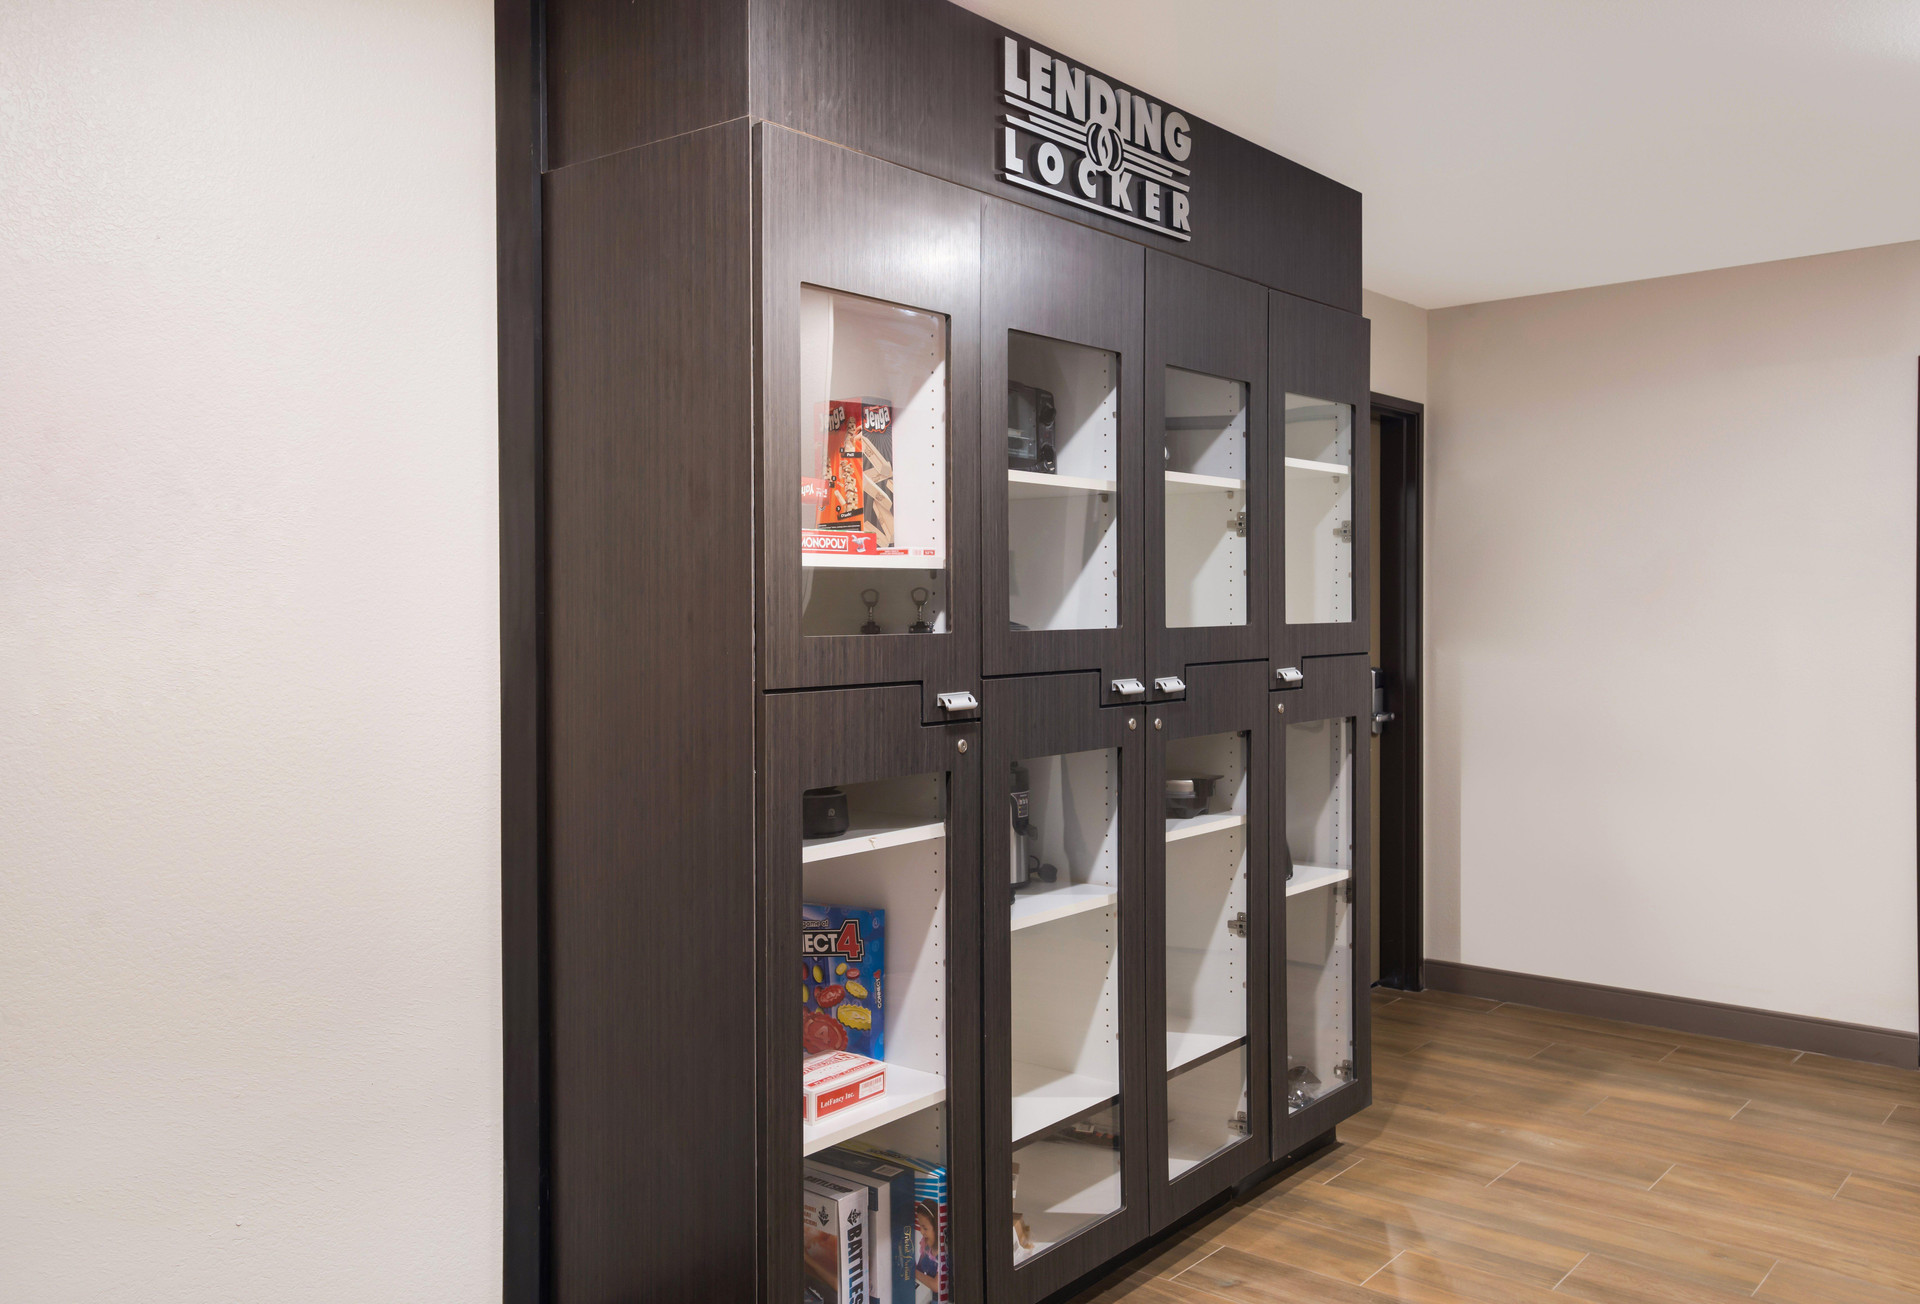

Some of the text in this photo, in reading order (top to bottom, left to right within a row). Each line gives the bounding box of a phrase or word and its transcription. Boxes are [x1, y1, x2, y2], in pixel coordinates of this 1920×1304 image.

[1005, 35, 1192, 162] LENDING
[1005, 126, 1192, 232] LOCKER
[864, 406, 890, 430] Jenga
